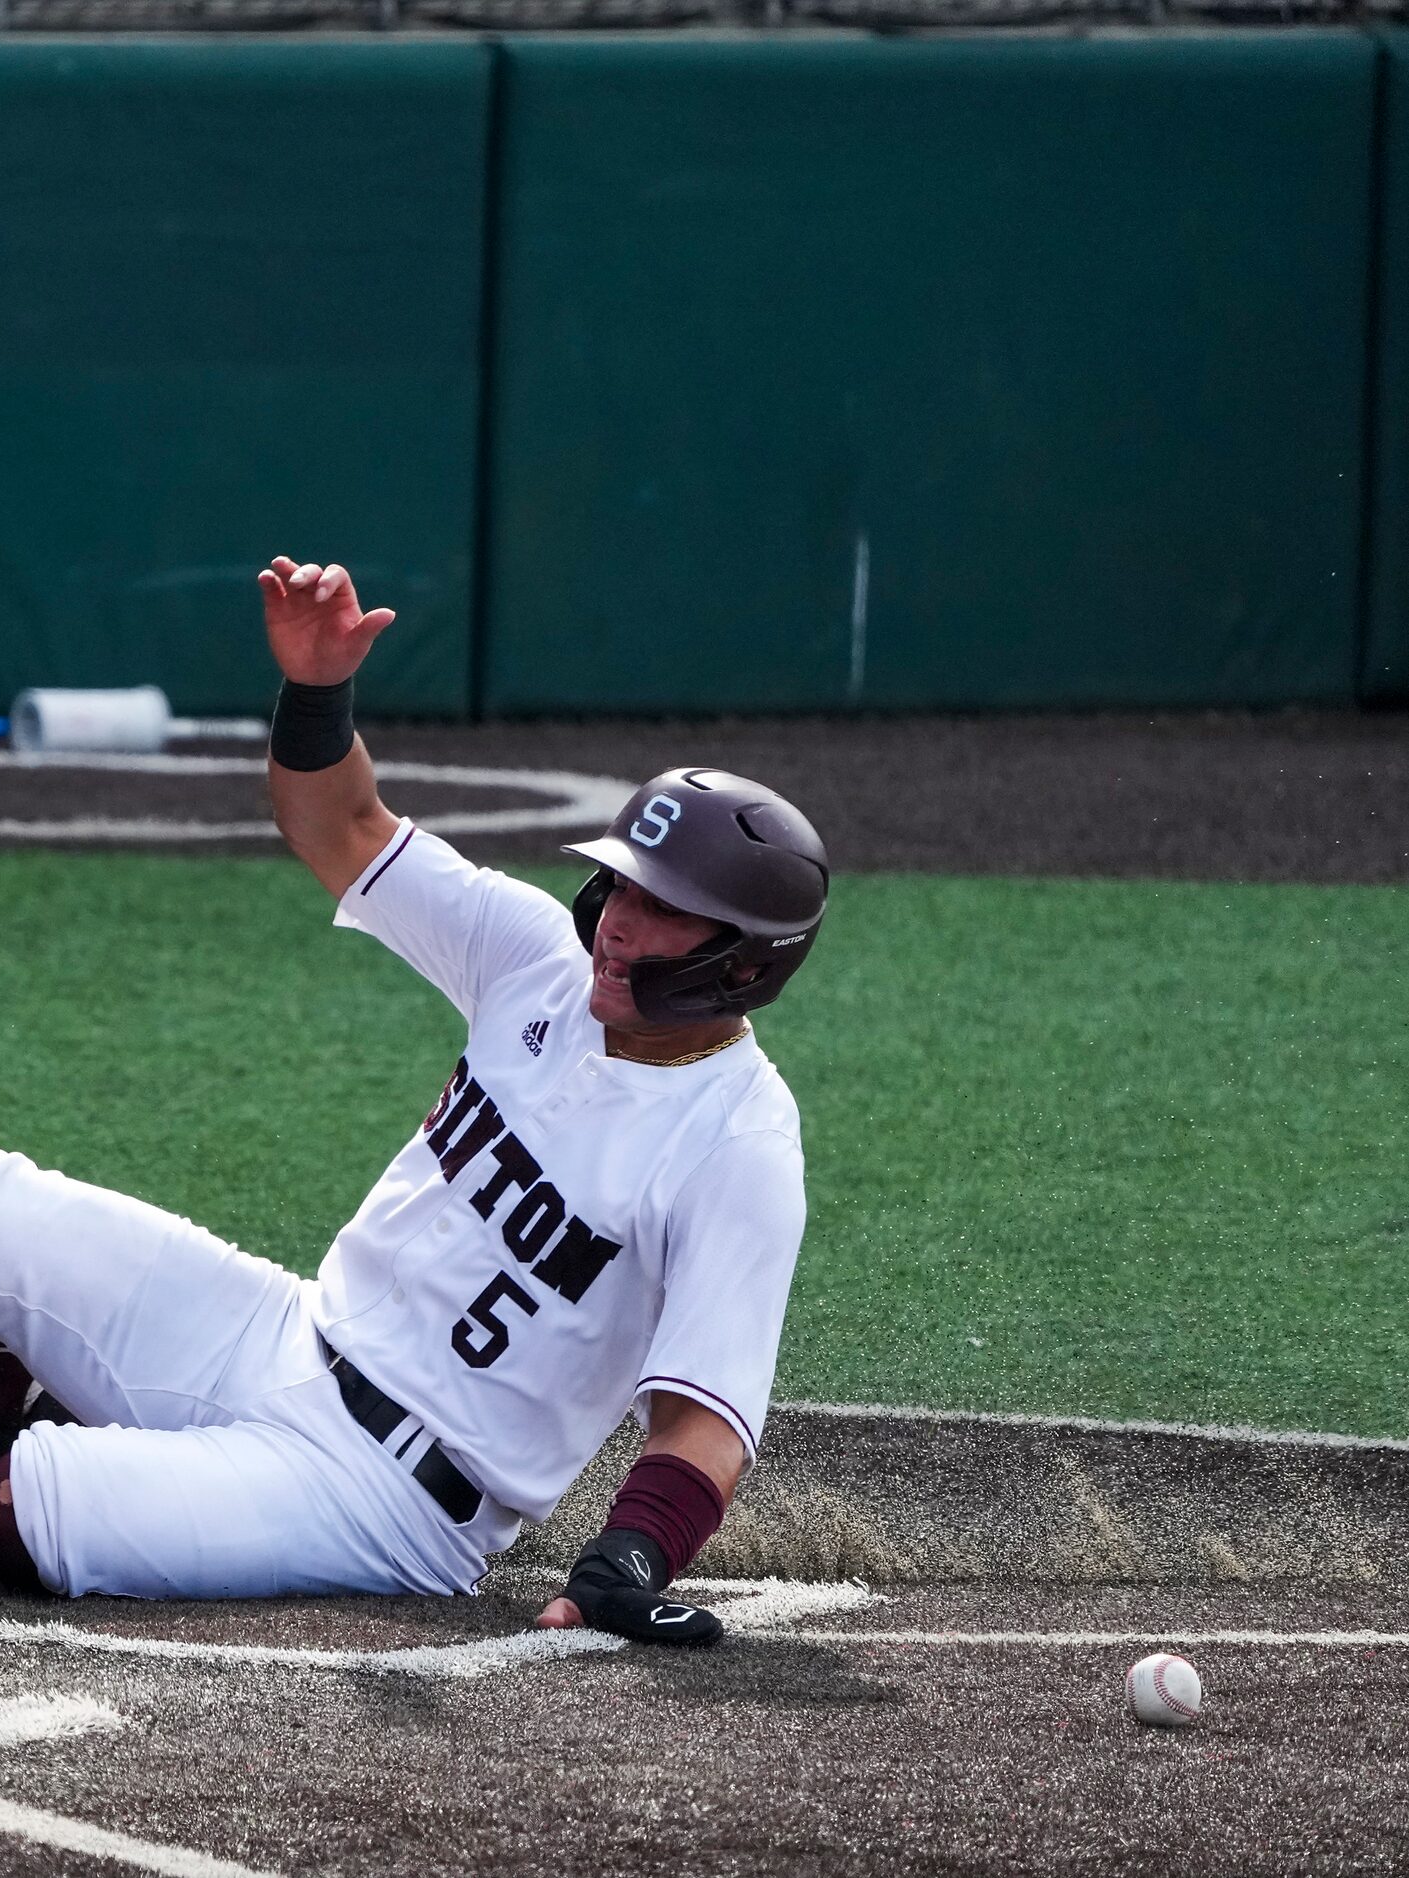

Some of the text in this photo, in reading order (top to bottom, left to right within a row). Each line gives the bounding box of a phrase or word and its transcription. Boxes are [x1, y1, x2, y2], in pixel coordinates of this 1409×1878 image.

[630, 794, 682, 848] S
[772, 933, 807, 948] EASTON
[522, 1027, 542, 1057] adidas
[424, 1055, 623, 1304] SINTON
[451, 1269, 540, 1369] 5
